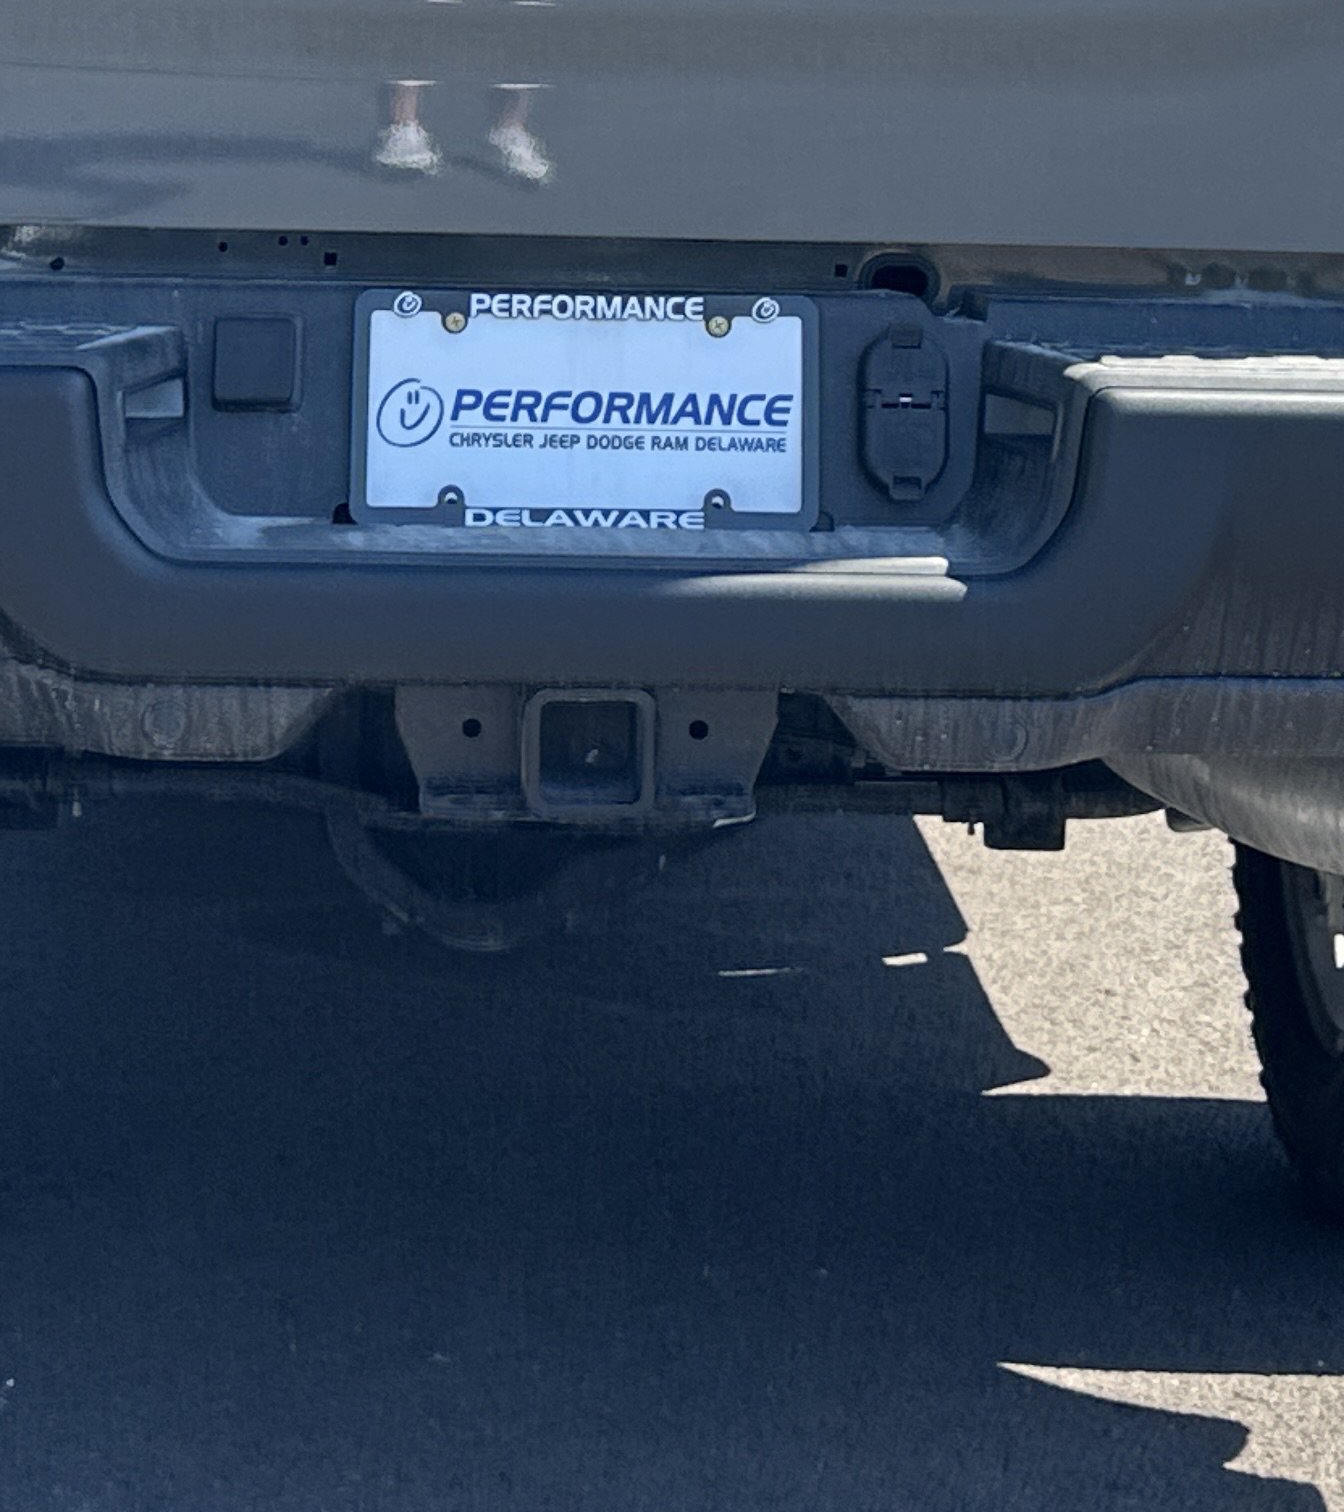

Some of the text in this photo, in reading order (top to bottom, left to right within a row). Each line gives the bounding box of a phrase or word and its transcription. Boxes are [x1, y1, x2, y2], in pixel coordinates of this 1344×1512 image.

[469, 293, 704, 321] PERFORMANCE
[450, 389, 794, 427] PERFORMANCE
[449, 432, 787, 453] CHRYSLER JEEP DODGE RAM DELAWARE
[464, 508, 705, 530] DELAWARE
